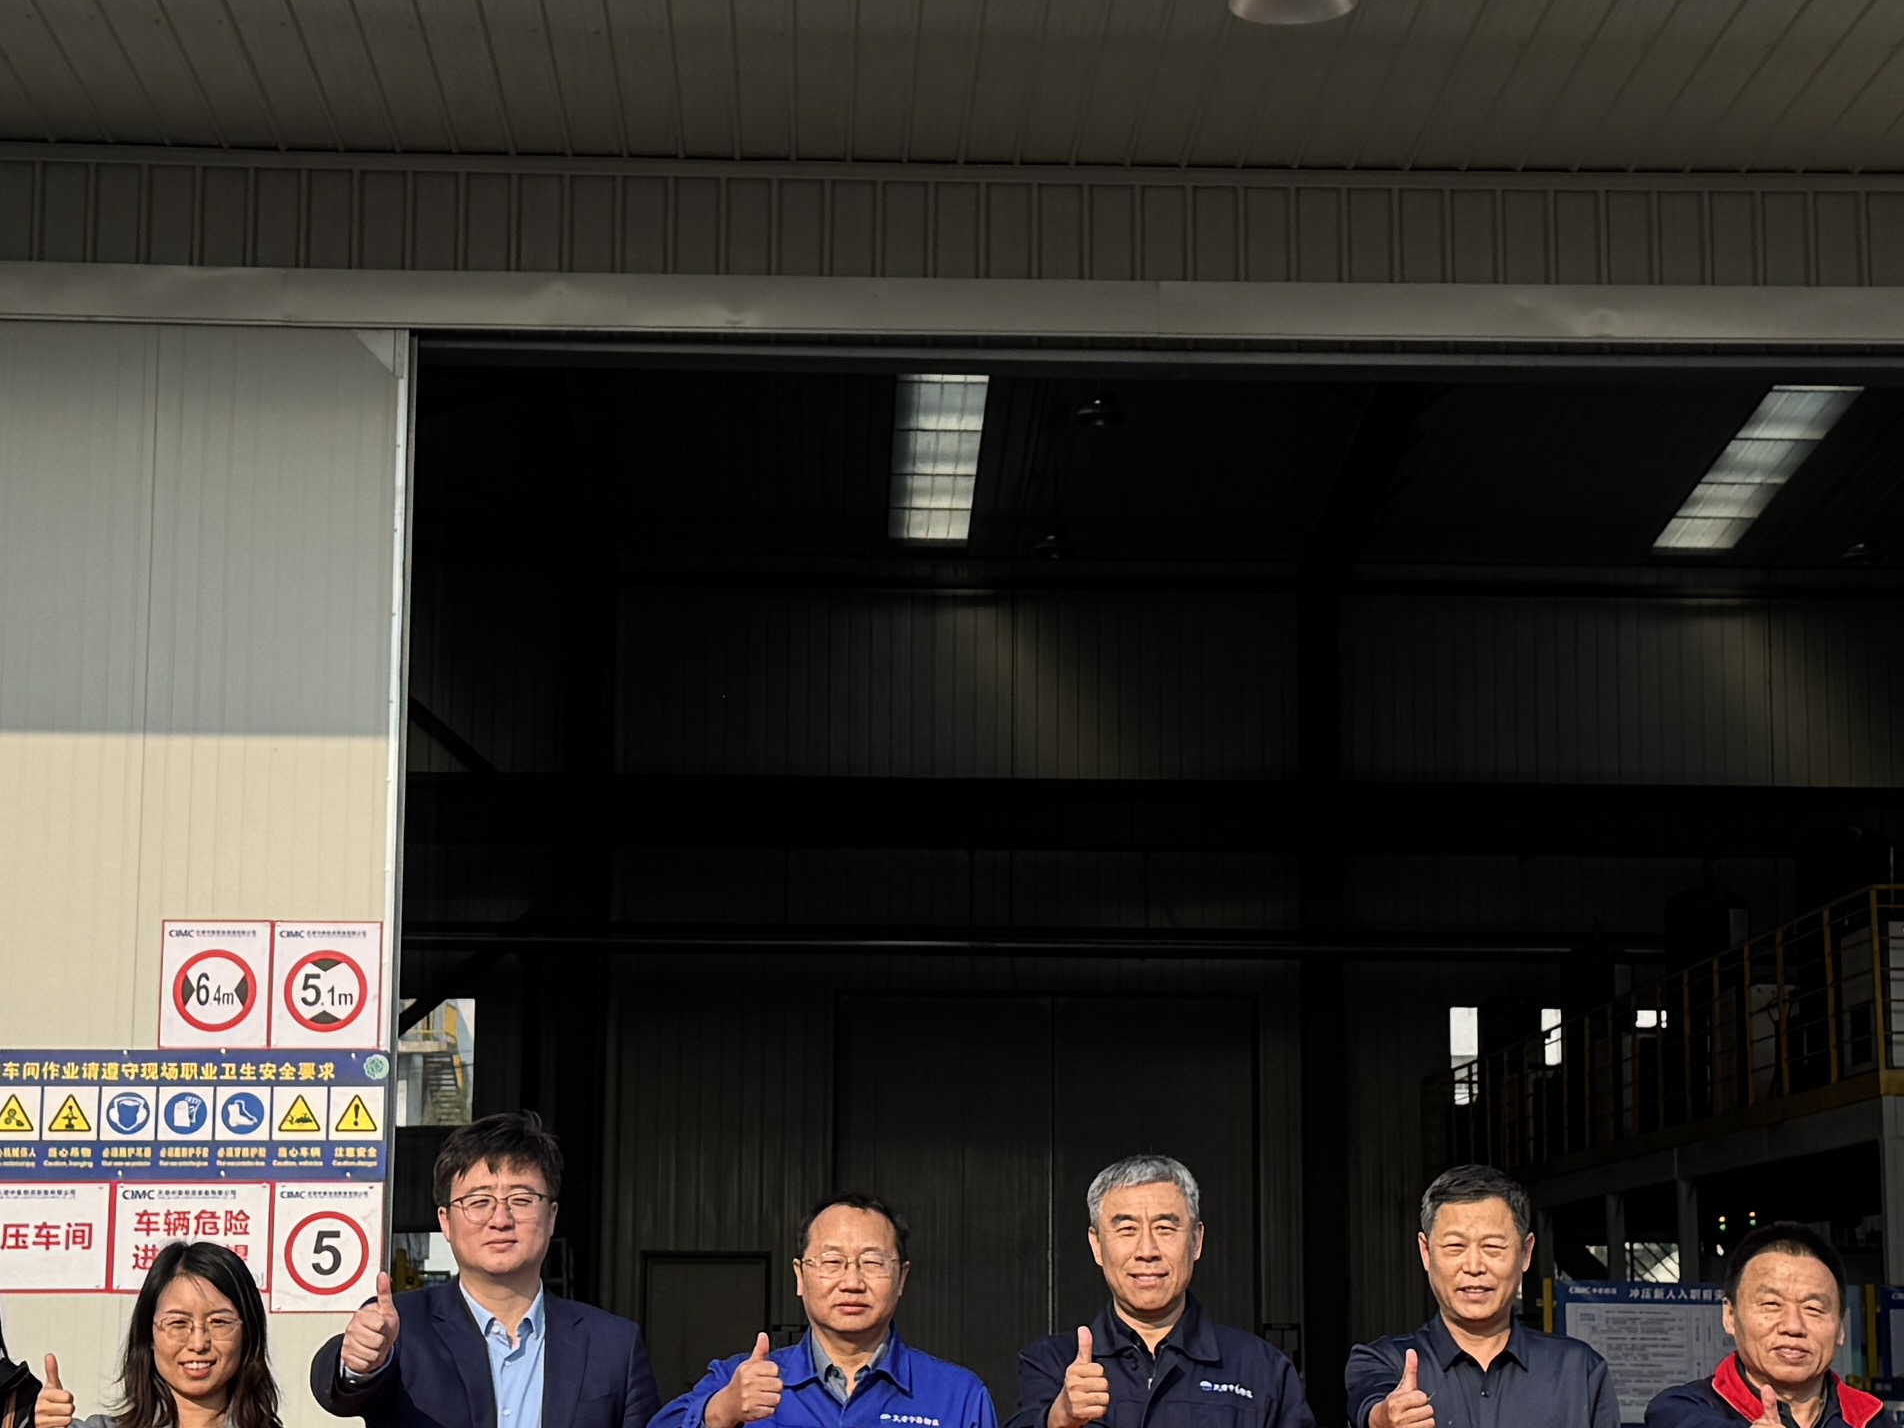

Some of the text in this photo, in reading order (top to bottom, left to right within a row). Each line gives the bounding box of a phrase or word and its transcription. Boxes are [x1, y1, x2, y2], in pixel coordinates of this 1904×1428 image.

[196, 972, 234, 1006] 6.4m
[301, 973, 354, 1007] 5.1m
[122, 1189, 156, 1200] CIMC
[133, 1209, 251, 1237] 车辆危险
[311, 1230, 343, 1276] 5
